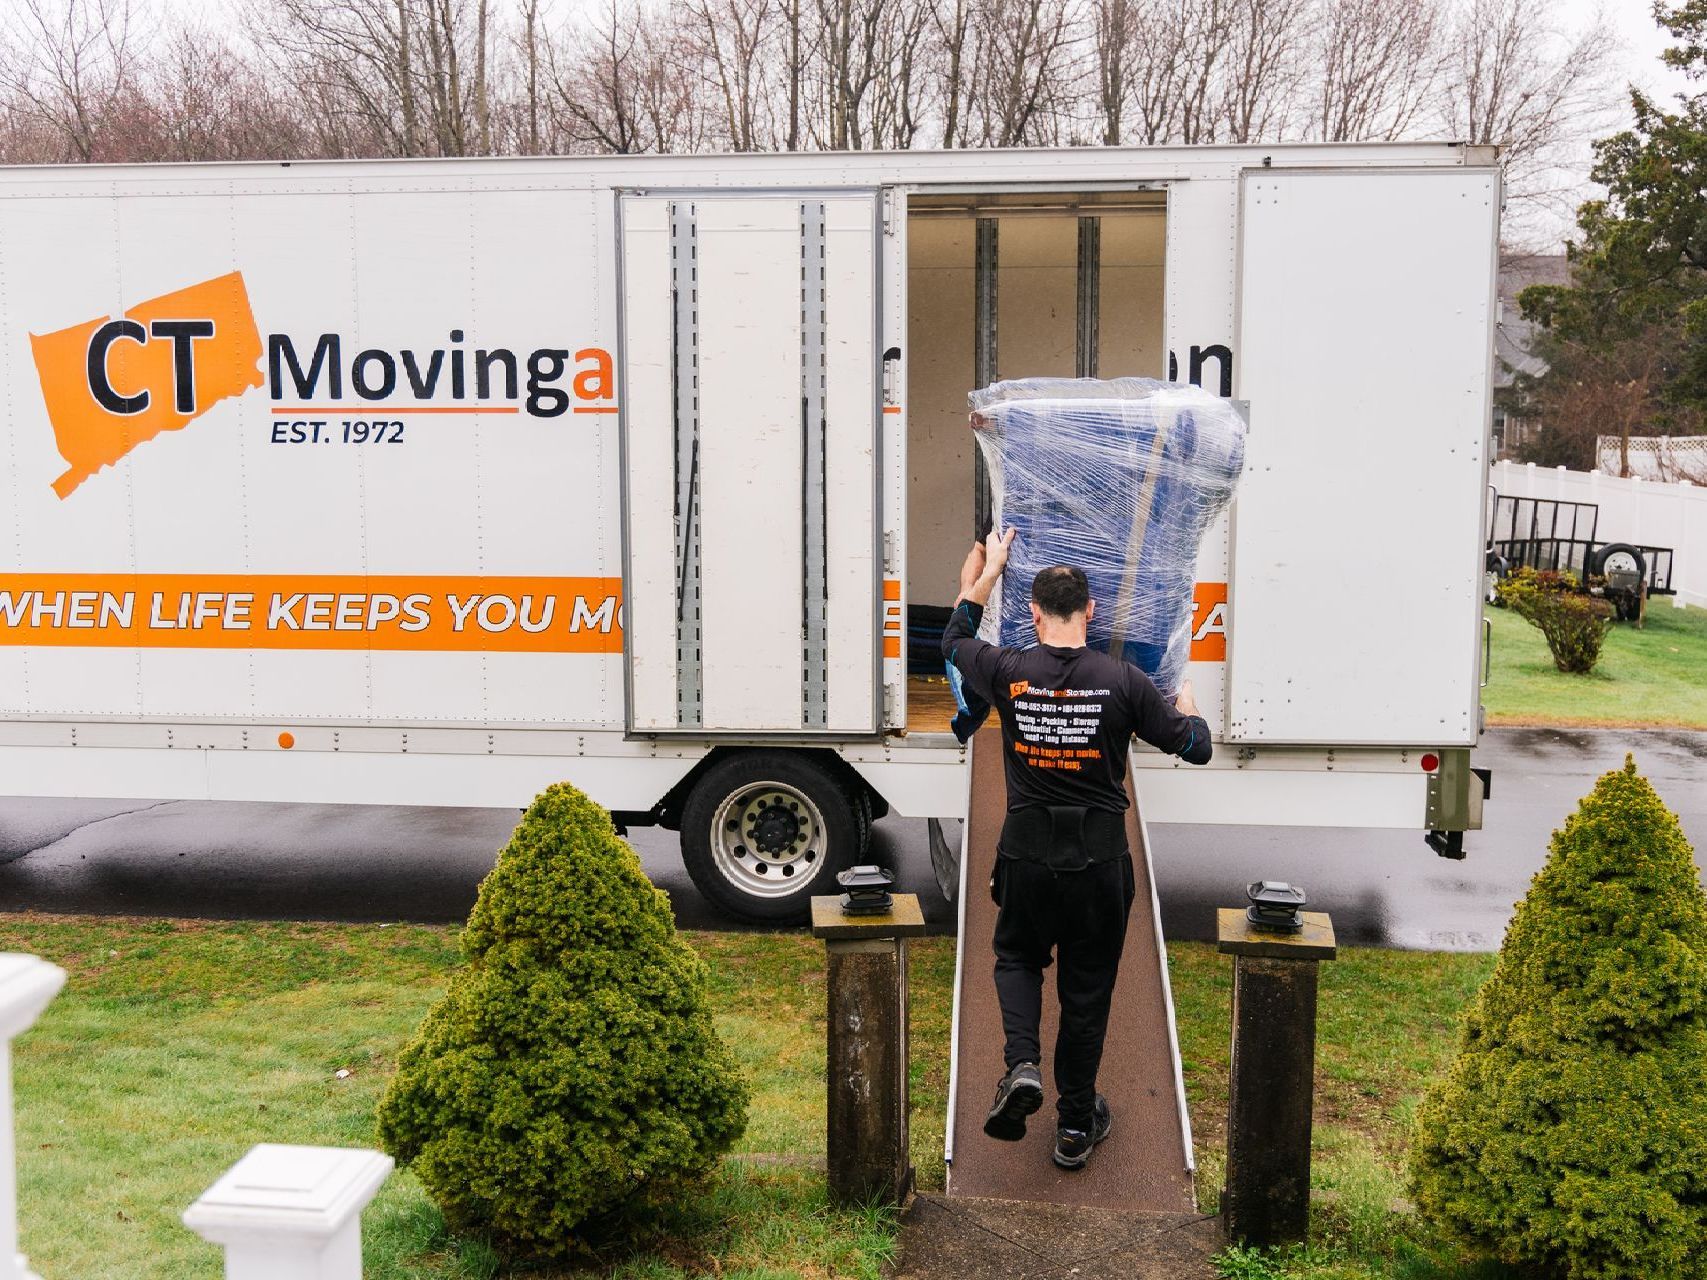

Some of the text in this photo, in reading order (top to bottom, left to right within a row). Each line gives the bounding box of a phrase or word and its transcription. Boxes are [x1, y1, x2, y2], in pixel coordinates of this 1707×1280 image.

[86, 319, 215, 416] CT
[270, 421, 404, 443] EST. 1972
[0, 591, 135, 628] WHEN
[150, 592, 252, 630] LIFE
[267, 593, 431, 631] KEEPS
[446, 594, 556, 633] YOU
[569, 595, 623, 633] M
[1041, 717, 1067, 727] Packing
